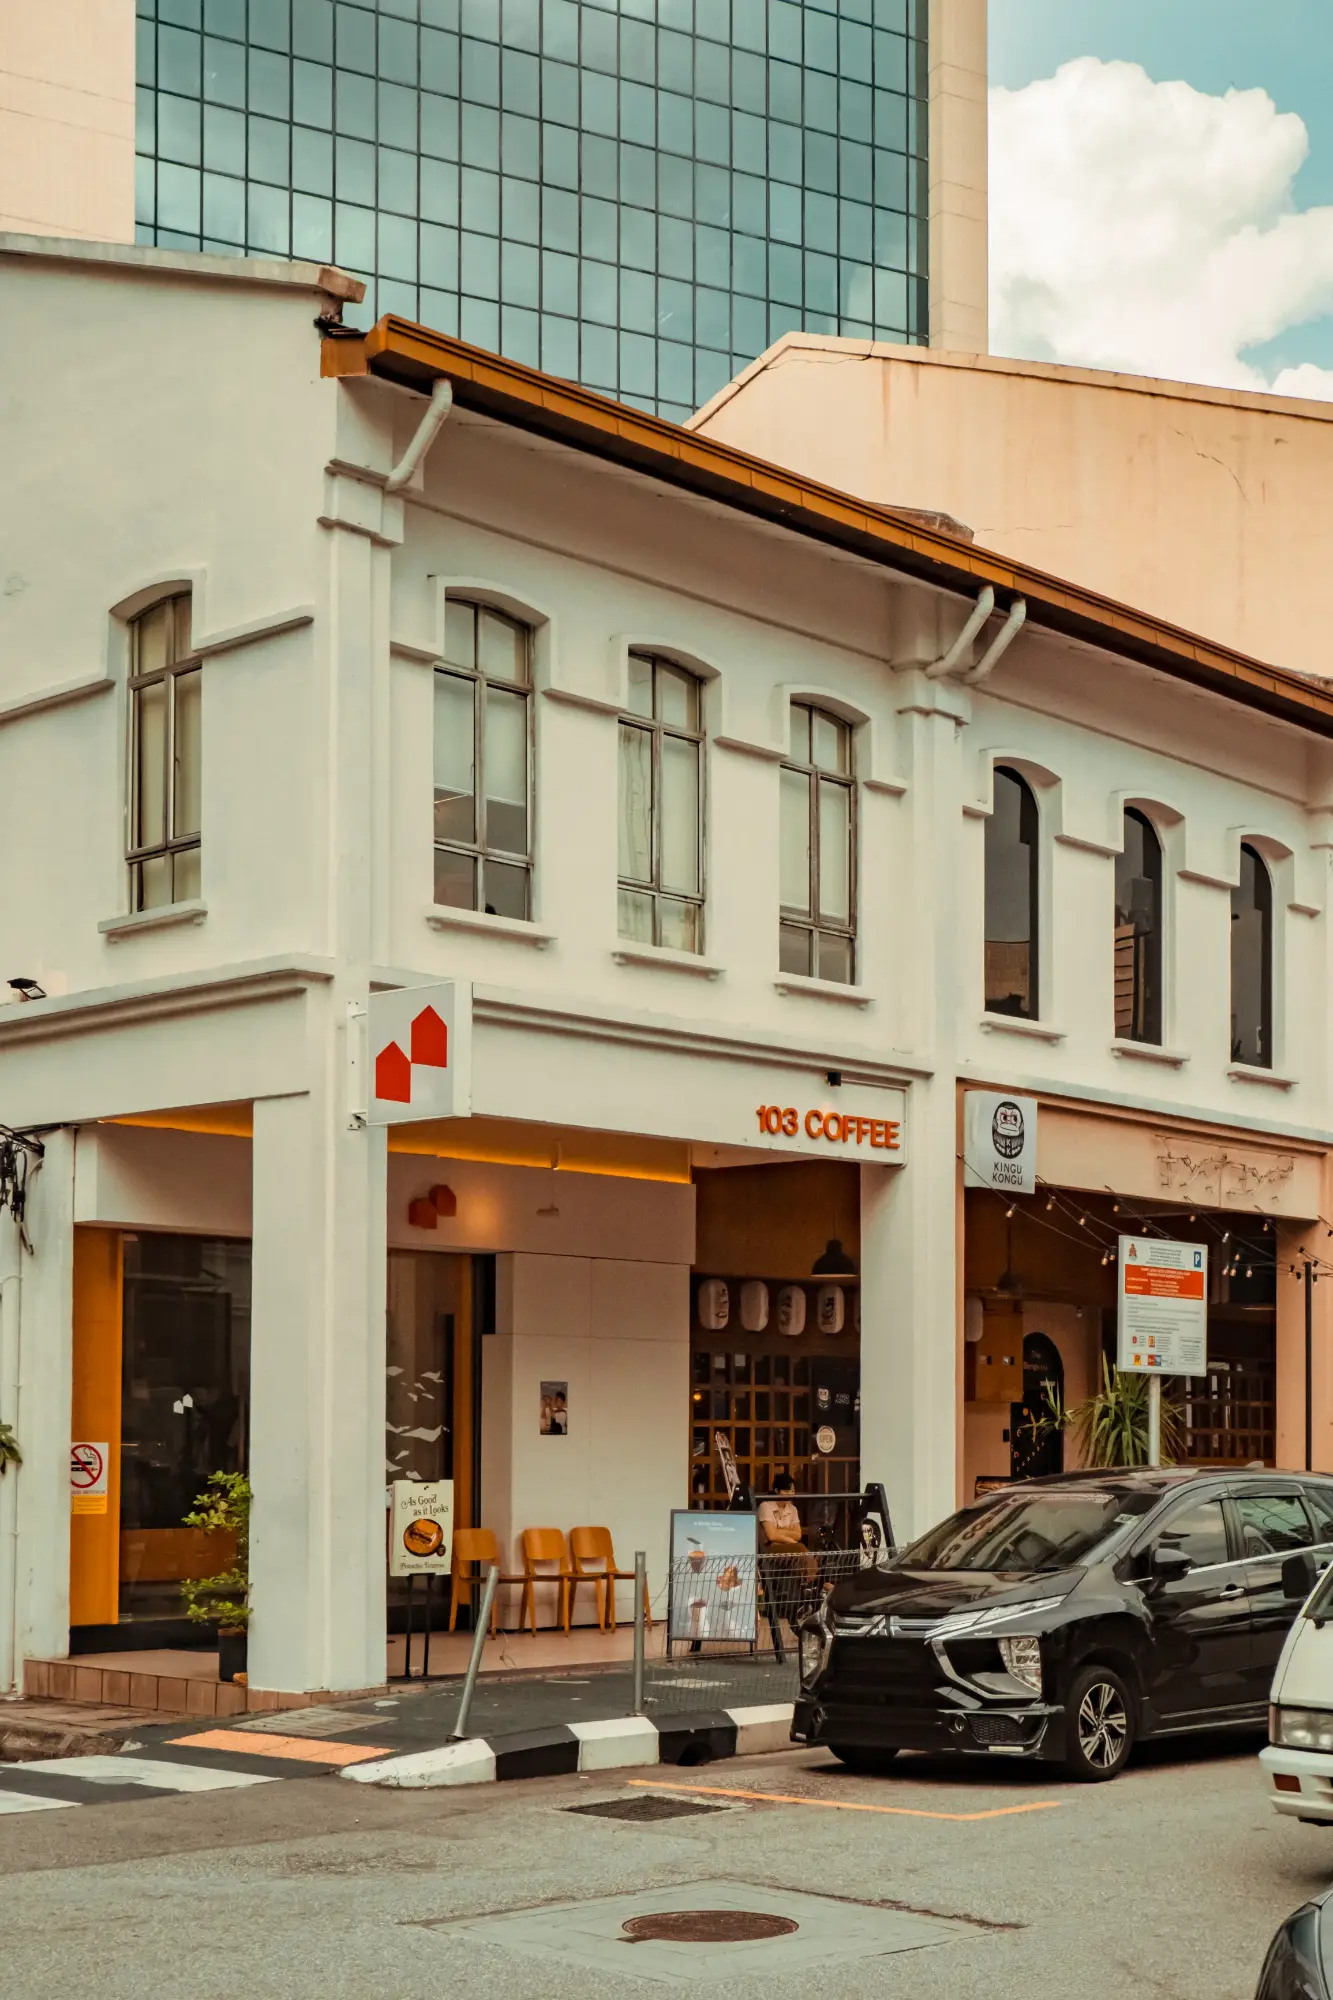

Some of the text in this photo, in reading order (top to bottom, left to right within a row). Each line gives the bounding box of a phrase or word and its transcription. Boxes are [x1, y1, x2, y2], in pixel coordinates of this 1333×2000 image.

[756, 1105, 900, 1149] 103 COFFEE
[993, 1161, 1022, 1174] KINGU
[992, 1173, 1023, 1185] KONGU
[400, 1494, 437, 1510] As Good
[423, 1506, 428, 1515] it
